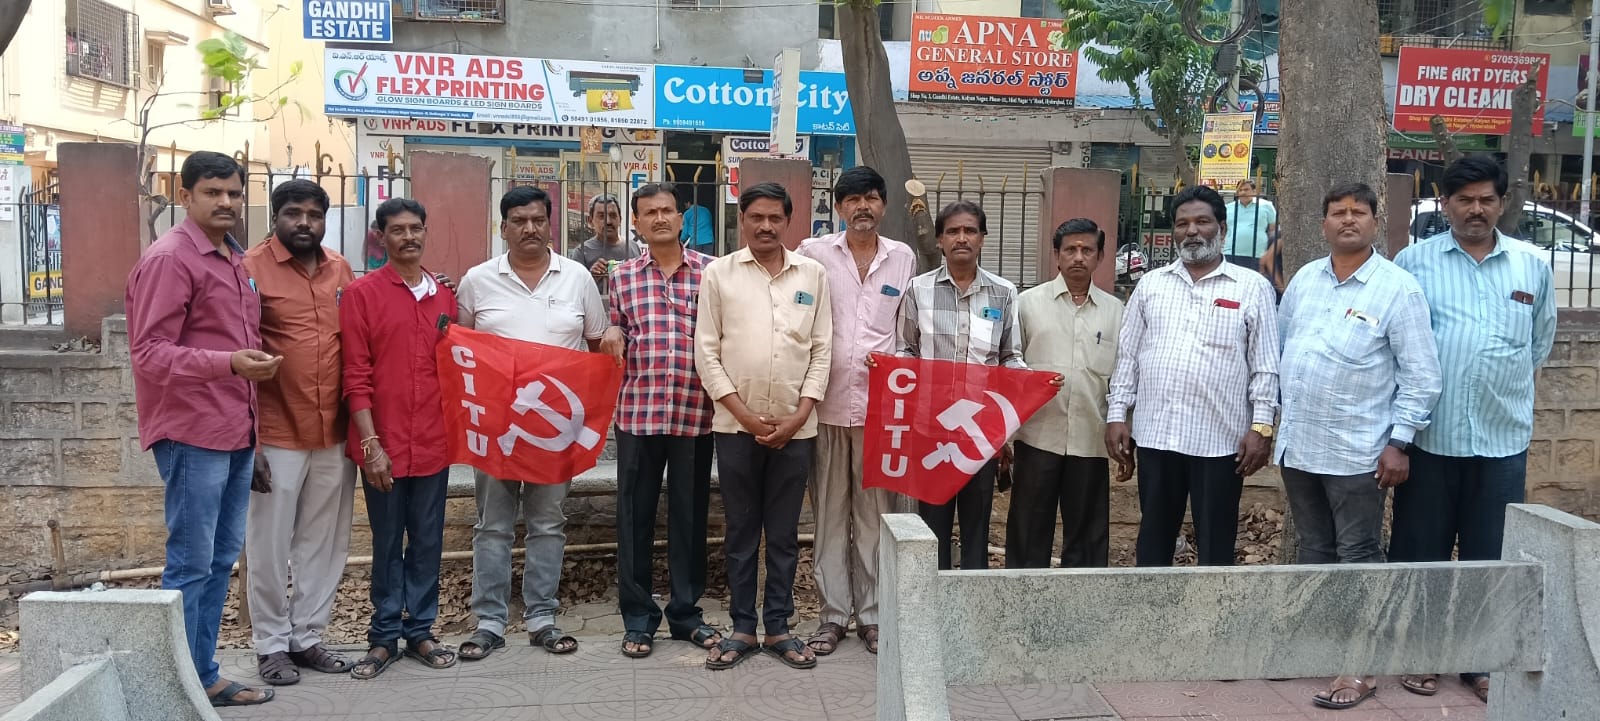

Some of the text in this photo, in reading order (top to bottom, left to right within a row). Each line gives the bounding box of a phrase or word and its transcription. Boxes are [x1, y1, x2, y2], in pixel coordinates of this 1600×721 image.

[309, 0, 384, 19] GANDHI
[312, 20, 383, 38] ESTATE
[953, 20, 1038, 48] APNA
[916, 47, 1072, 68] GENERAL STORE
[394, 55, 523, 80] VNR ADS
[1418, 66, 1528, 84] FINE ART DYERS
[377, 76, 545, 100] FLEX PRINTING
[664, 77, 772, 107] Cotton
[1400, 85, 1440, 106] DRY
[427, 98, 461, 106] BOARDS
[382, 118, 446, 131] VNR ADS
[452, 121, 505, 134] FLX
[1389, 148, 1445, 160] EANE
[820, 170, 838, 180] Ciy
[1144, 235, 1171, 246] XER
[34, 276, 64, 291] GAND
[451, 346, 488, 457] CITU
[881, 368, 917, 477] CITU
